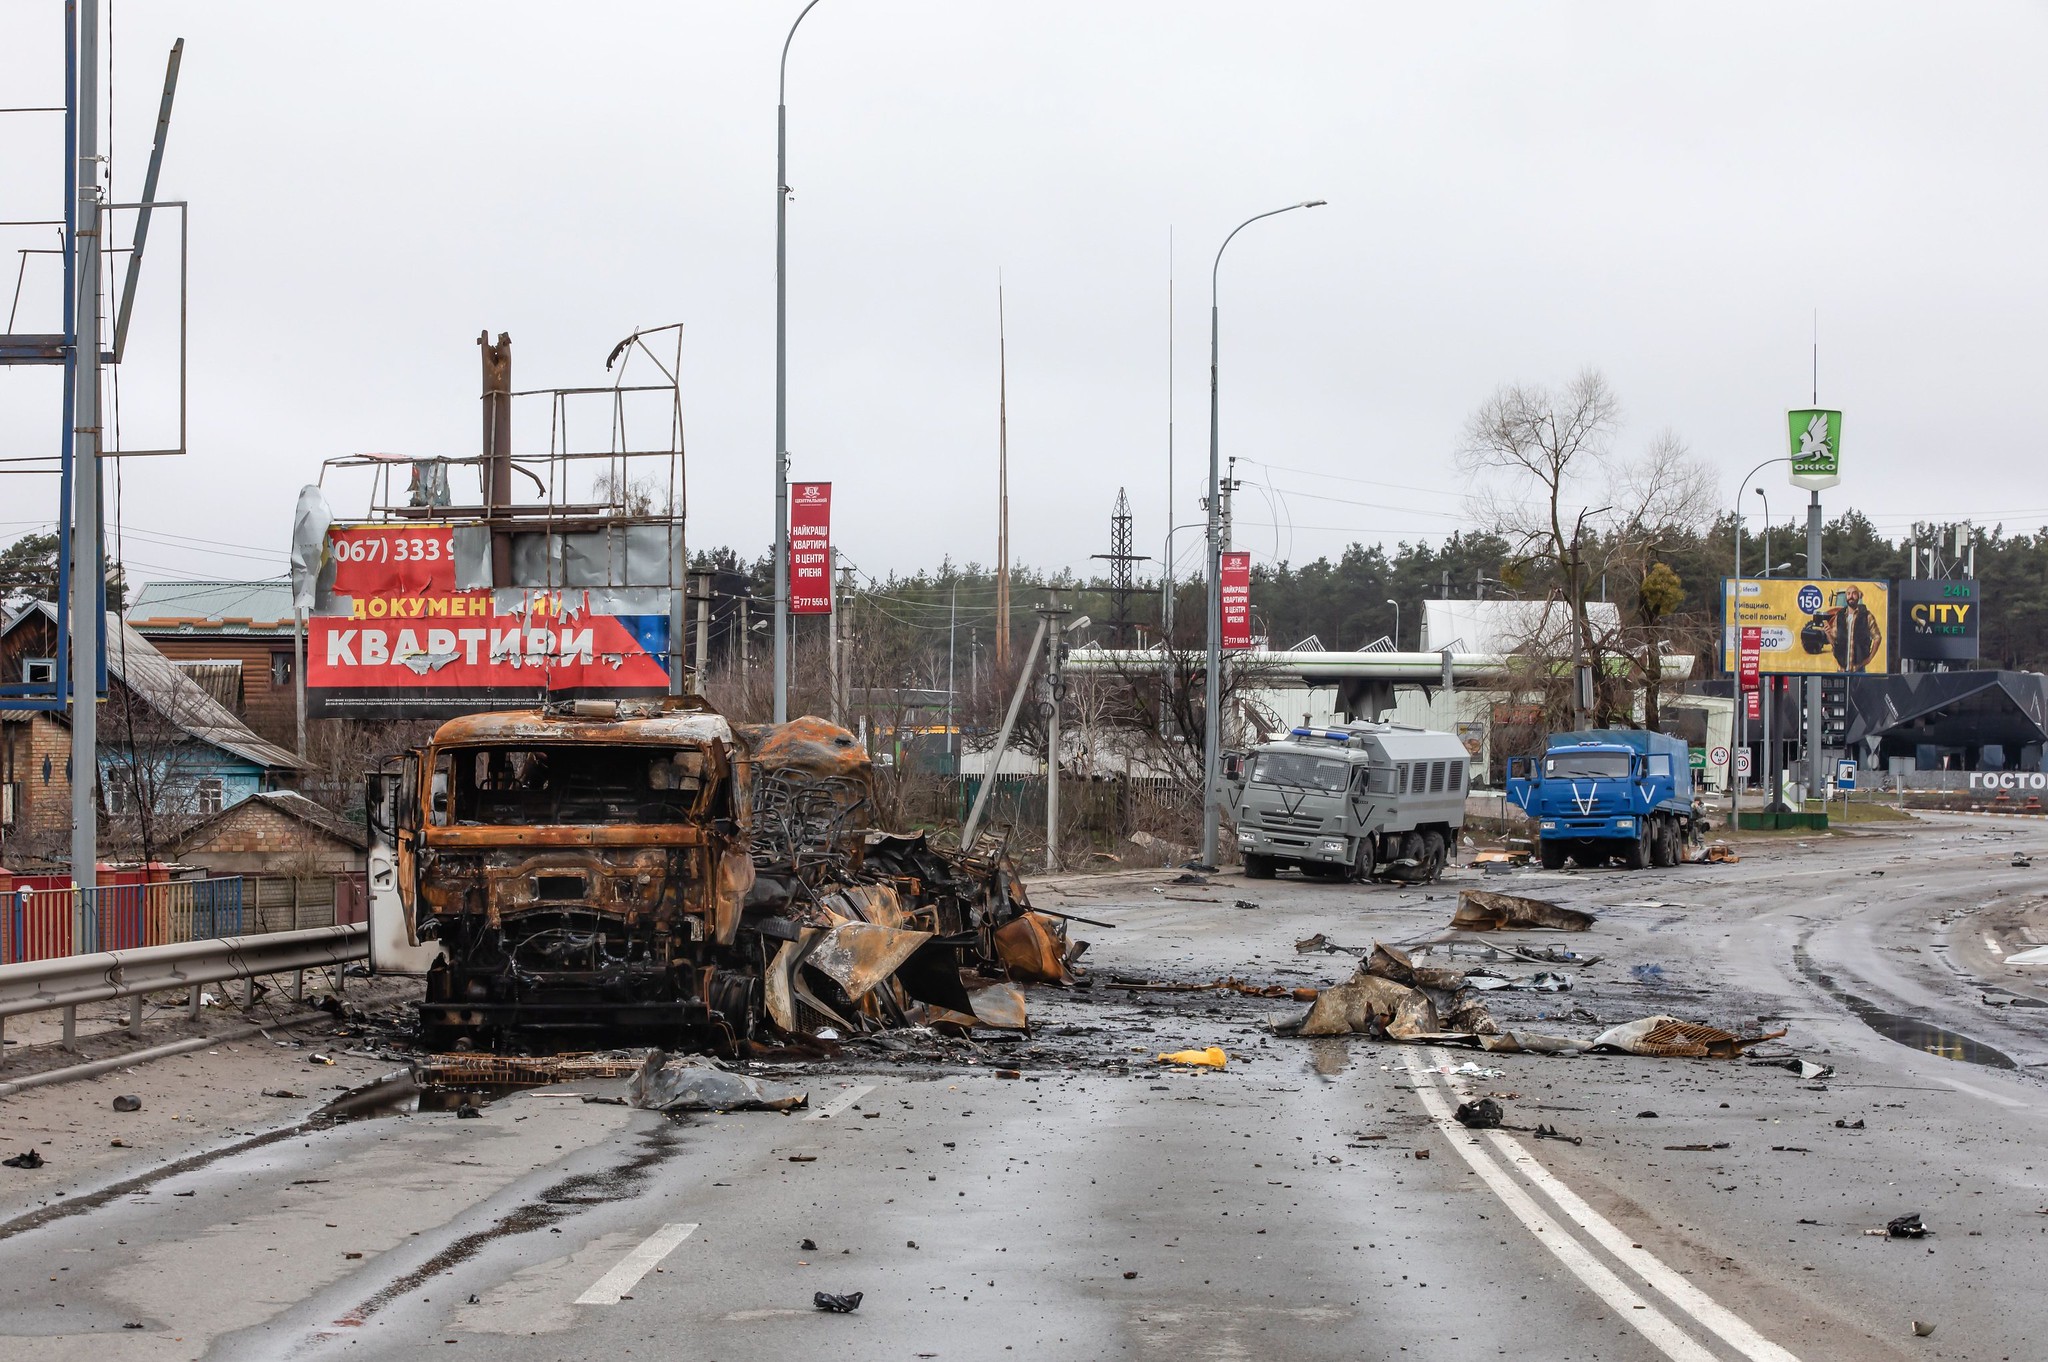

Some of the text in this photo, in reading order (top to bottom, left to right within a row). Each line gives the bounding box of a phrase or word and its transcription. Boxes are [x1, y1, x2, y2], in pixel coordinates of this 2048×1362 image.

[793, 525, 828, 537] НАЙКРАЩІ
[394, 538, 440, 561] 333
[793, 540, 827, 550] КВАРТИРИ
[795, 554, 825, 565] В ЦЕНТРІ
[798, 568, 822, 577] ІРПЕНЯ
[1944, 585, 1970, 597] 24h
[800, 597, 811, 606] 777
[1734, 602, 1771, 610] иївщино,
[1799, 595, 1821, 609] 150
[1760, 613, 1787, 621] ловить!
[1911, 604, 1970, 625] CITY
[327, 628, 594, 669] КВАРТИРИ
[1969, 772, 2048, 789] ГОСТО
[1228, 788, 1242, 810] V
[1515, 786, 1532, 810] V
[1572, 783, 1597, 815] V
[1640, 785, 1655, 804] V
[1281, 793, 1306, 816] V
[1352, 804, 1375, 827] V
